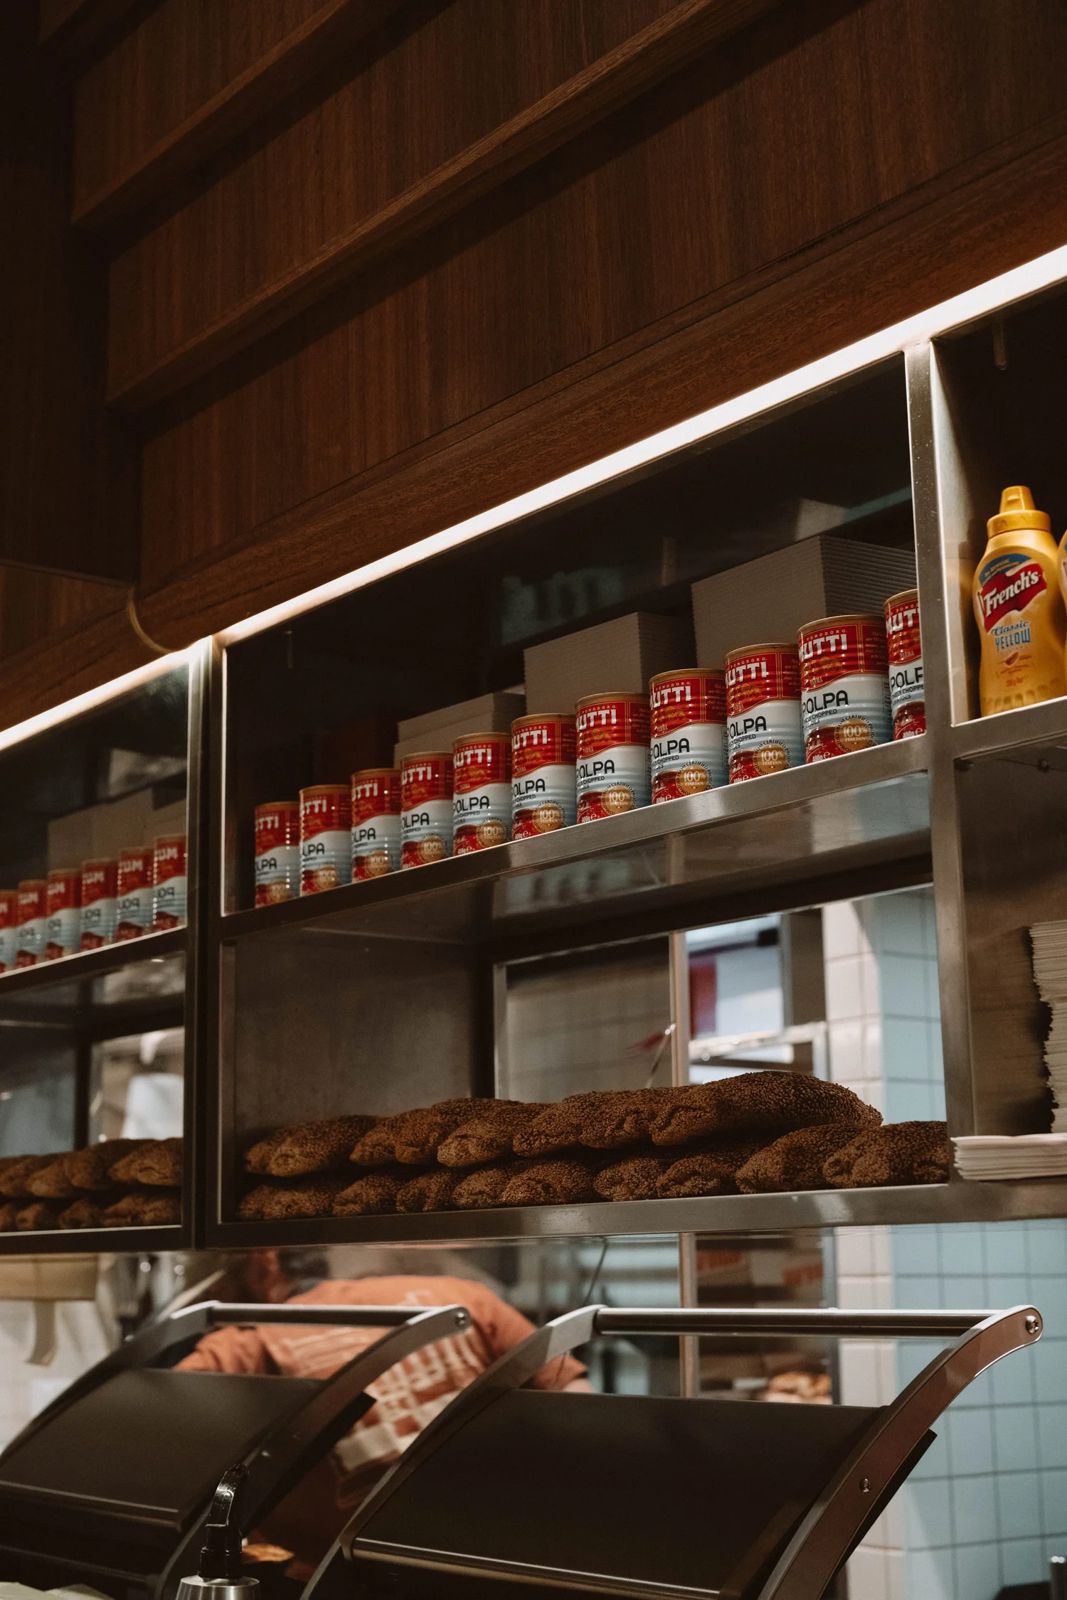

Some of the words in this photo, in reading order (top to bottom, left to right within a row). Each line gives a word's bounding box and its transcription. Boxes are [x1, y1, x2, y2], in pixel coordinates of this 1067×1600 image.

[983, 570, 1041, 617] French's
[992, 620, 1029, 637] Classic
[995, 628, 1031, 649] YELLOW
[727, 716, 767, 739] OLPA
[512, 729, 548, 752] UTTI
[651, 738, 690, 759] OLPA
[513, 778, 546, 798] OLPA
[256, 815, 279, 832] TTI
